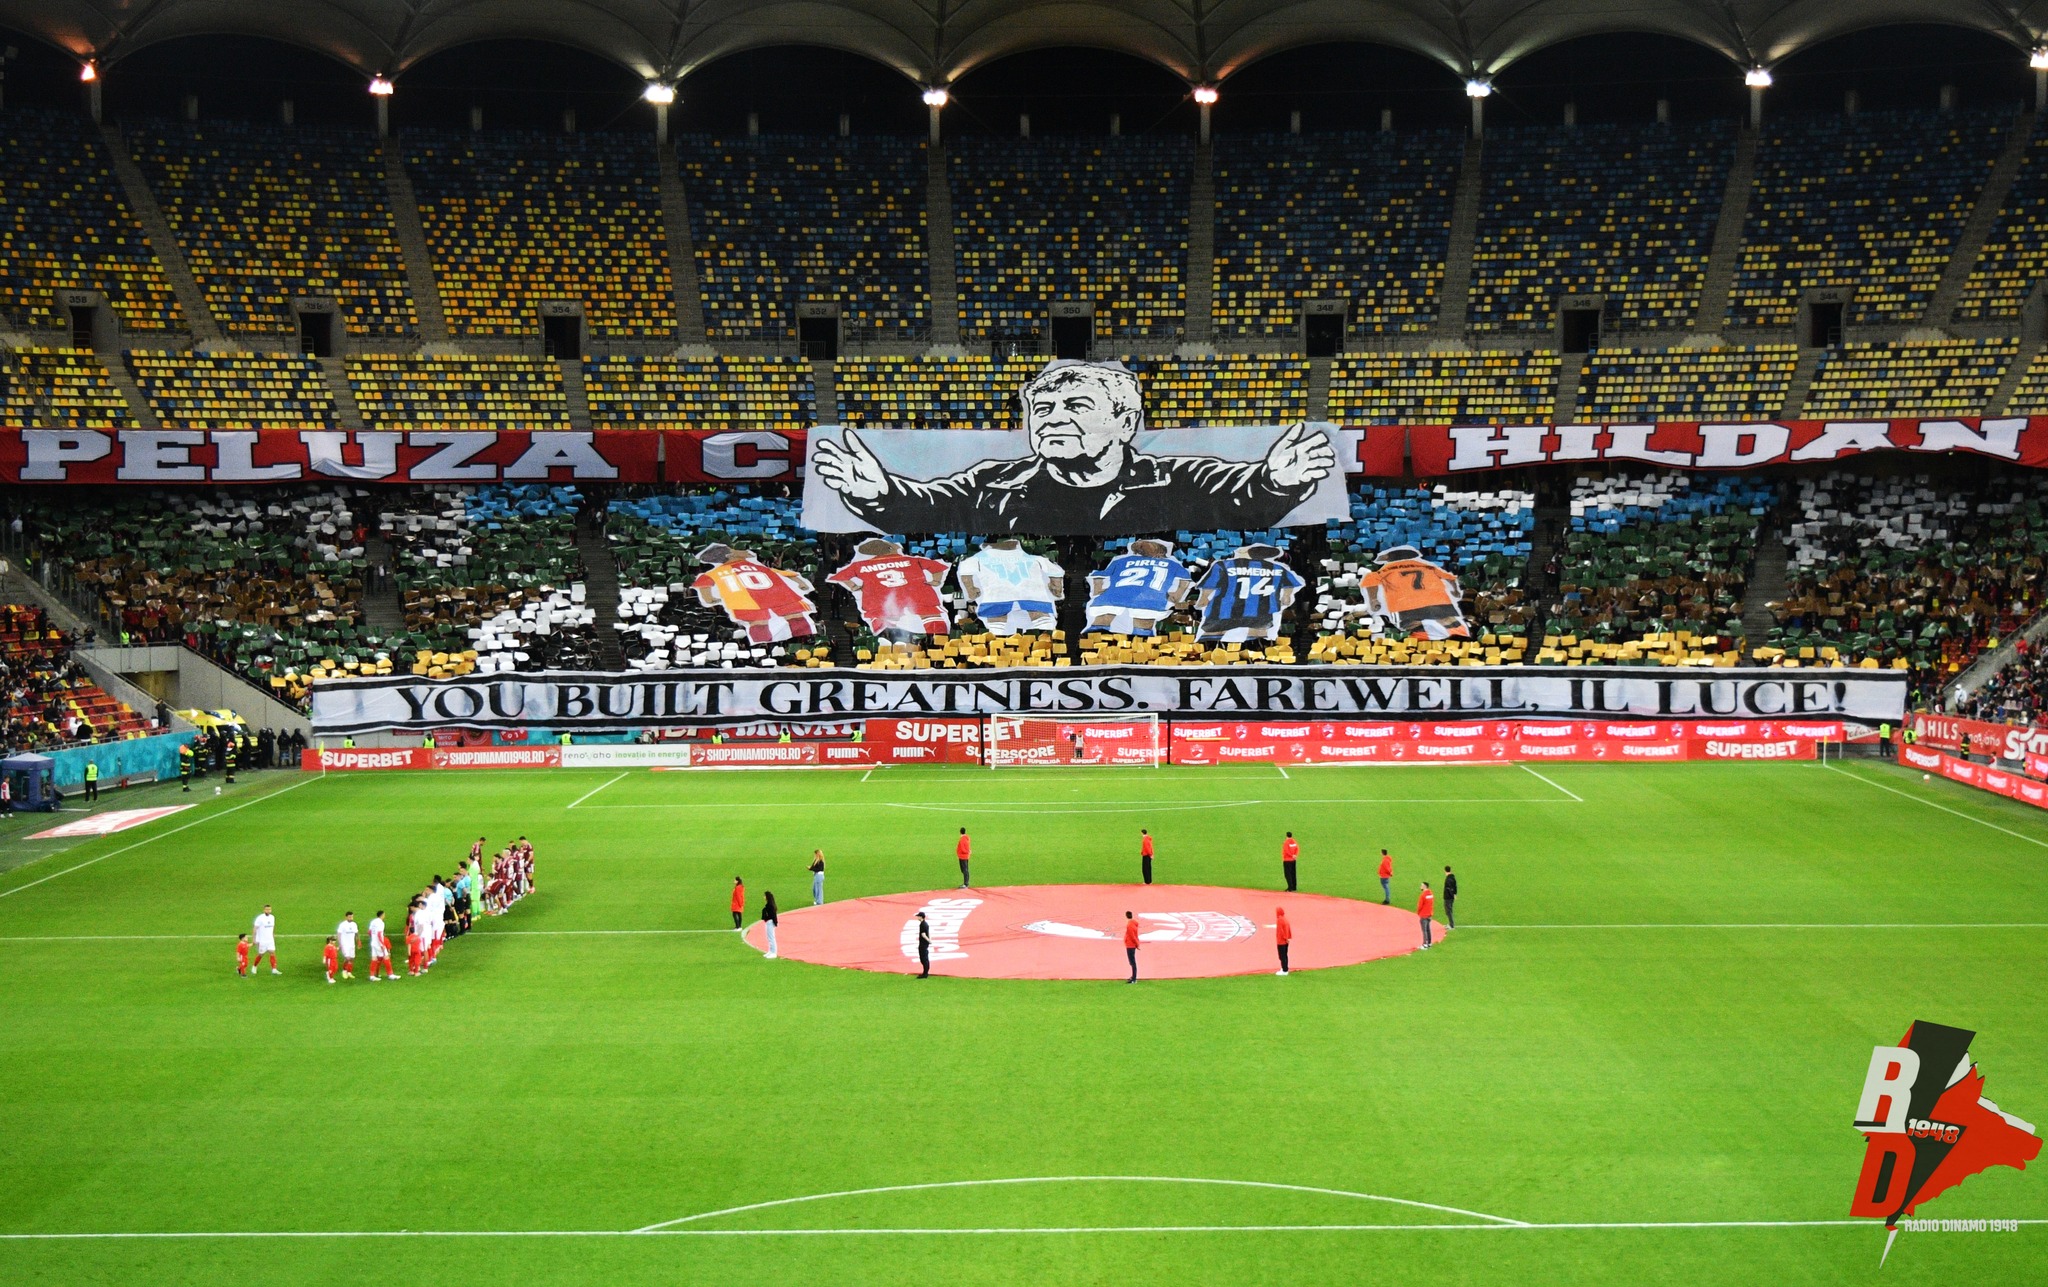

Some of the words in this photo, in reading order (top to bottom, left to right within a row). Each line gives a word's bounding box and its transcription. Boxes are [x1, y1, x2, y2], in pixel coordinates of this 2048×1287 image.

[1448, 417, 2029, 470] HILDAN
[19, 430, 619, 480] PELUZA
[860, 560, 911, 573] ANDONE
[1125, 559, 1170, 569] PIRLO
[1227, 566, 1284, 577] SIMEONE
[721, 572, 774, 592] 10
[876, 569, 908, 588] 3
[1115, 566, 1170, 591] 21
[1400, 570, 1425, 590] 7
[1236, 577, 1276, 599] 14
[395, 683, 526, 720] YOU
[553, 682, 735, 717] BUILT
[759, 676, 1149, 714] GREATNESS.
[1175, 677, 1539, 712] FAREWELL,
[1567, 679, 1629, 712] IL
[1655, 680, 1847, 715] LUCE!
[896, 719, 1024, 742] SUPERBET
[1085, 728, 1133, 738] SUPERBET
[1173, 727, 1222, 738] SUPERBET
[1261, 726, 1310, 738] SUPERBET
[1345, 726, 1394, 737] SUPERBET
[1434, 725, 1483, 737] SUPERBET
[1522, 725, 1572, 737] SUPERBET
[1606, 725, 1656, 737] SUPERBET
[1696, 725, 1746, 736] SUPERBET
[1786, 725, 1836, 737] SUPERBET
[1927, 720, 1958, 740] HILS
[658, 750, 688, 759] energie
[707, 747, 800, 761] SHOP.DINAMO1948.RO
[827, 747, 859, 758] PUMA
[893, 746, 925, 757] PUMA
[966, 745, 1055, 760] SUPERSCORE
[1219, 745, 1275, 757] SUPERBET
[1321, 745, 1377, 757] SUPERBET
[1417, 744, 1474, 756] SUPERBET
[1520, 744, 1577, 756] SUPERBET
[1622, 744, 1679, 756] SUPERBET
[1705, 740, 1798, 758] SUPERBET
[321, 750, 413, 768] SUPERBET
[450, 751, 545, 765] SHOP.DINAMO1948.RO
